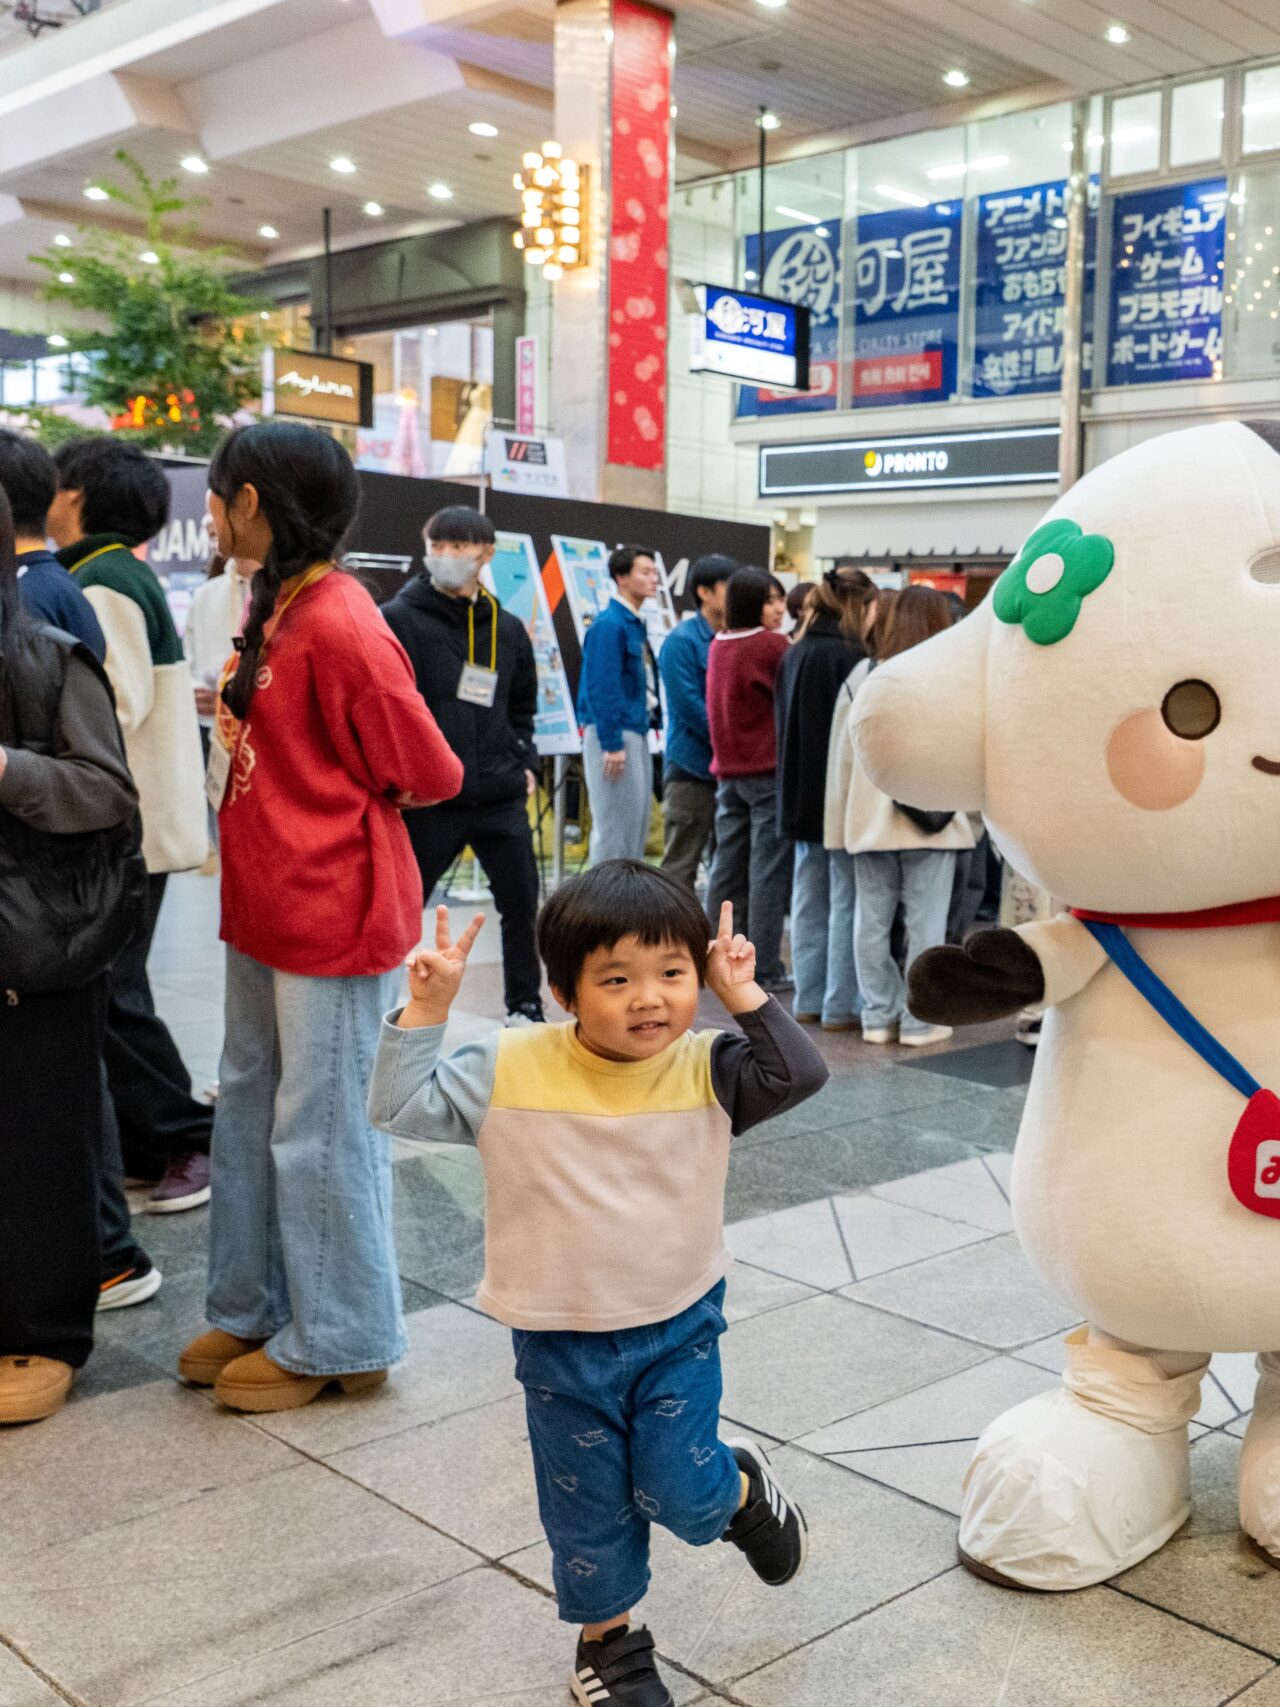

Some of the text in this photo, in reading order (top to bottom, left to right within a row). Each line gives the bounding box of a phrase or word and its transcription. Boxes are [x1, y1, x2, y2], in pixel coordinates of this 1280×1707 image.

[1122, 200, 1228, 243] フィギュア
[1139, 246, 1205, 282] ゲーム
[1118, 285, 1224, 325] プラモデル
[1111, 327, 1224, 365] ボードゲーム
[883, 450, 949, 474] PRONTO
